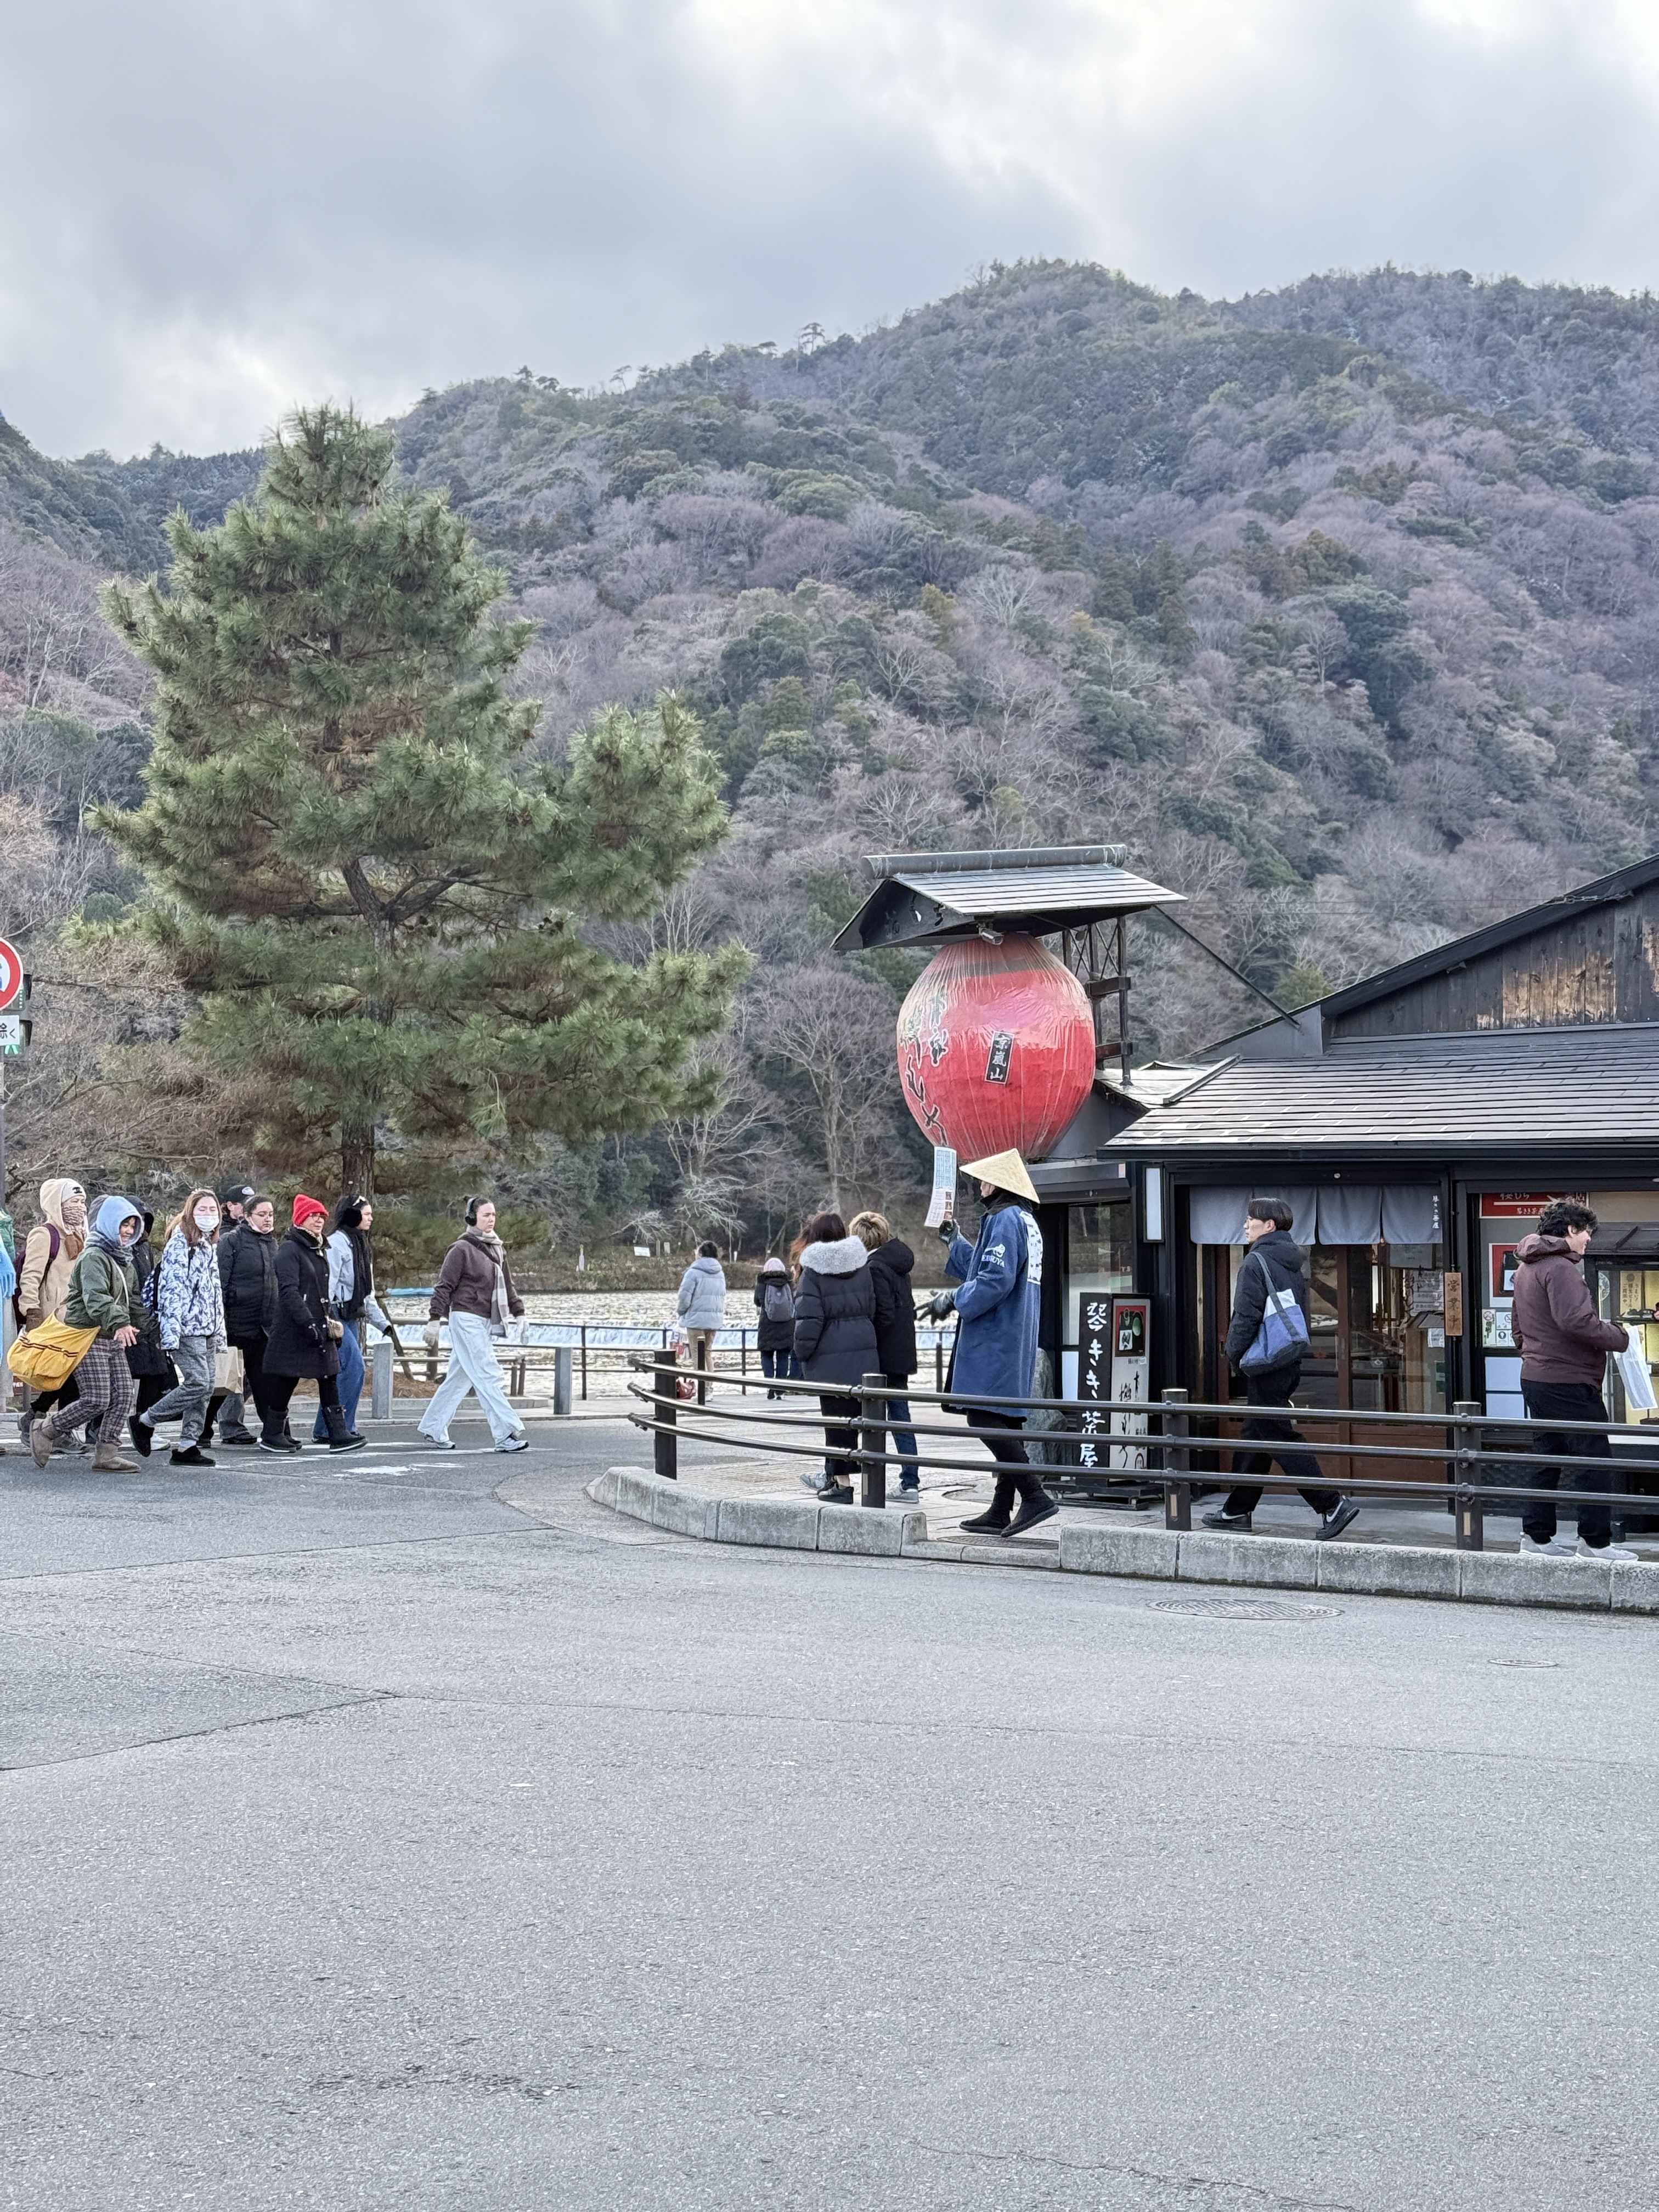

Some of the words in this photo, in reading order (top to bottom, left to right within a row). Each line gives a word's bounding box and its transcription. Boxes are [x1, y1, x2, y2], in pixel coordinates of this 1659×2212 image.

[990, 1035, 1011, 1081] 京嵐山
[1447, 1279, 1460, 1329] 営業中
[1079, 1302, 1107, 1468] 琴きき茶屋
